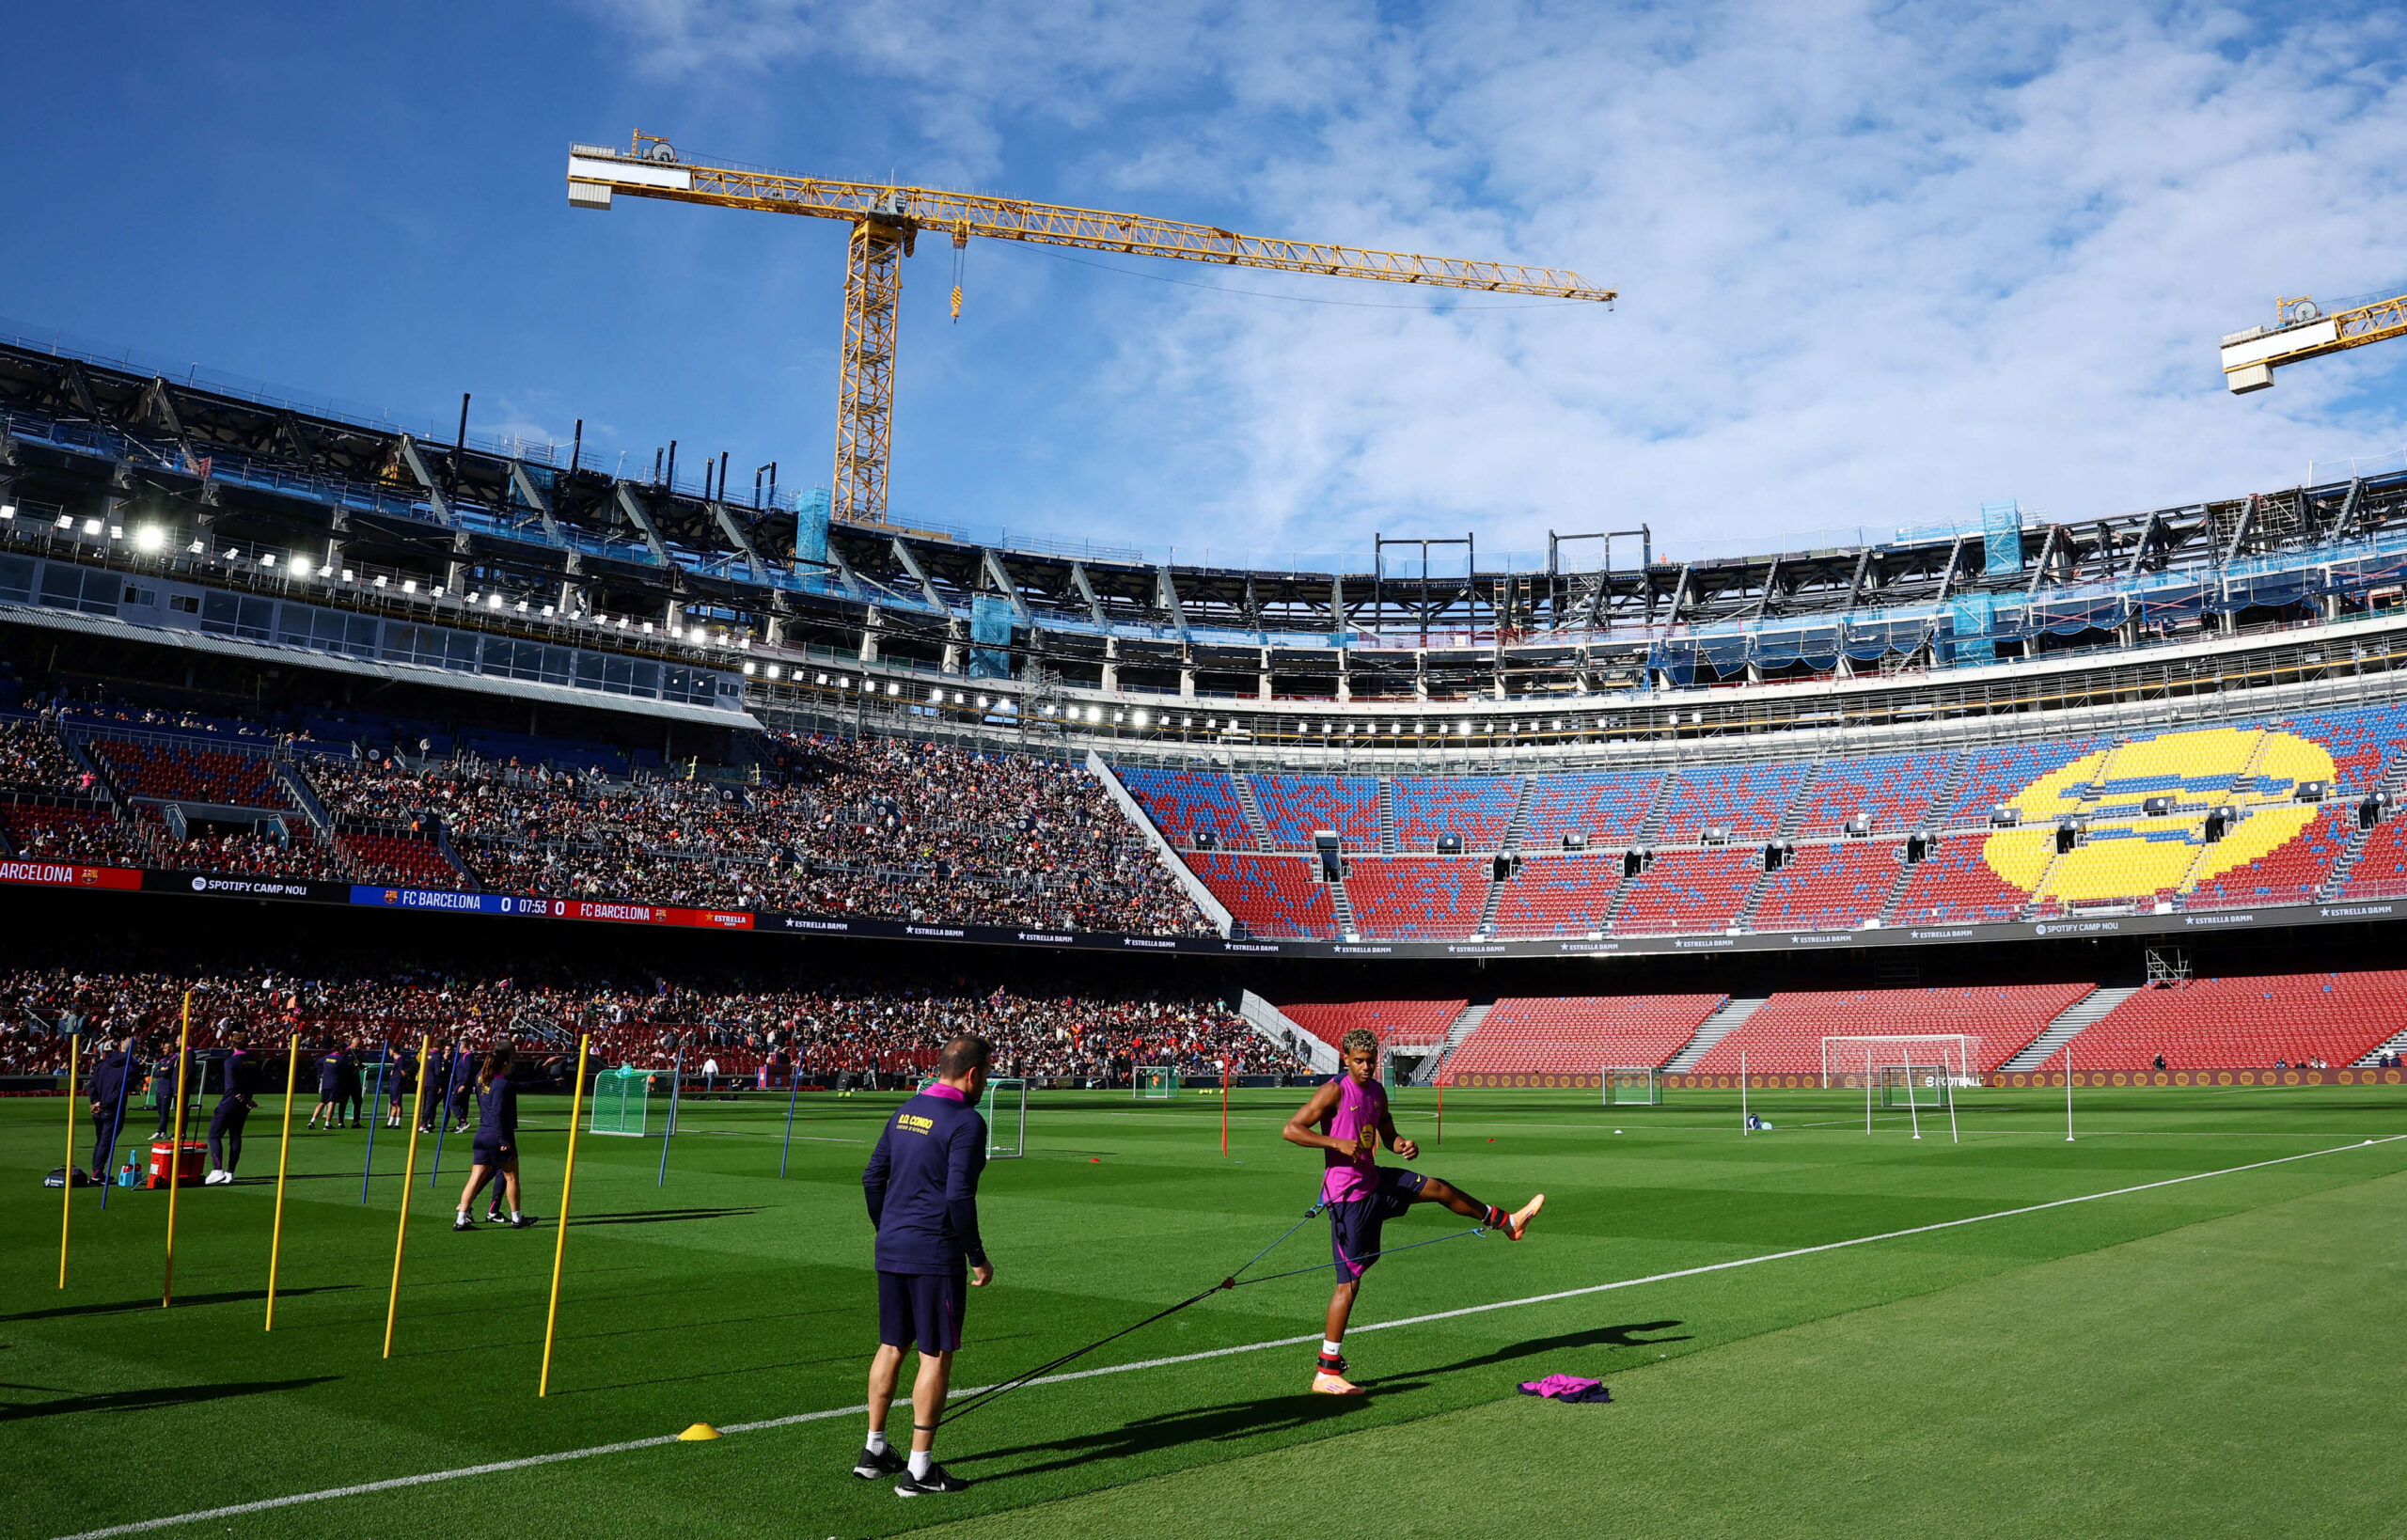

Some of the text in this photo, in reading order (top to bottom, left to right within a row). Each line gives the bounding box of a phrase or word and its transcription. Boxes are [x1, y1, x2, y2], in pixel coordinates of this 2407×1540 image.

[208, 880, 307, 895] SPOTIFY CAMP NOU
[402, 890, 480, 910] FC BARCELONA
[501, 897, 511, 912] 0
[518, 899, 547, 914] 07:53
[555, 901, 565, 916] 0
[580, 903, 650, 921] FC BARCELONA
[2331, 905, 2392, 917] ESTRELLA DAMM
[714, 915, 746, 923] ESTRELLA
[794, 920, 826, 929] ESTRELLA
[2195, 916, 2229, 924] ESTRELLA
[914, 927, 964, 937] ESTRELLA DAMM
[2047, 921, 2118, 934] SPOTIFY CAMP NOU
